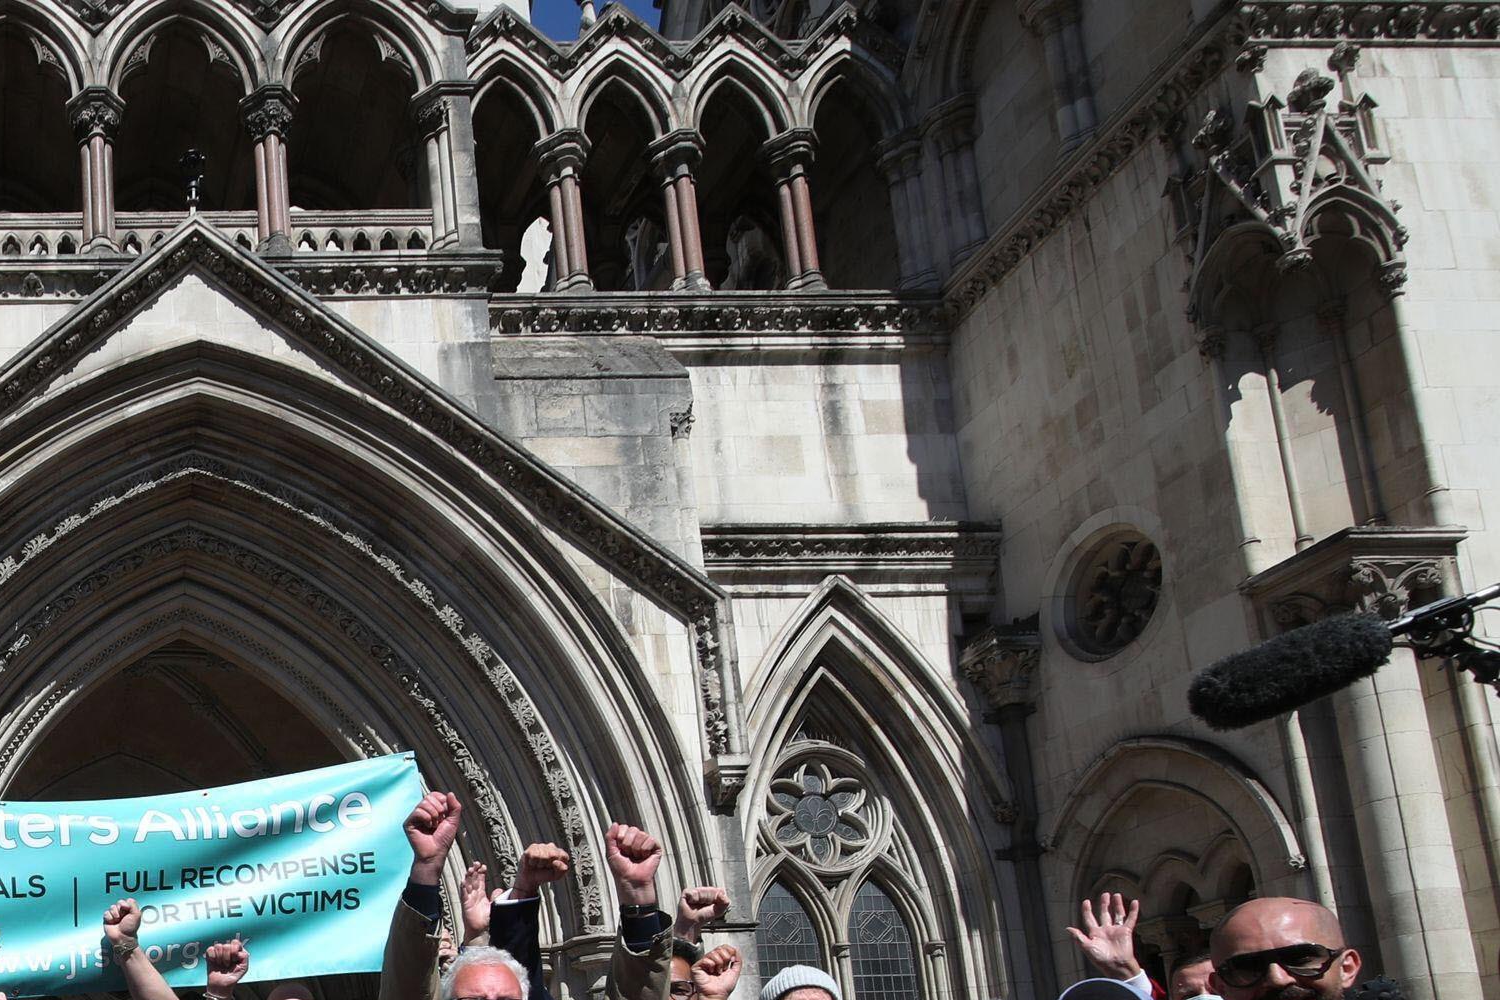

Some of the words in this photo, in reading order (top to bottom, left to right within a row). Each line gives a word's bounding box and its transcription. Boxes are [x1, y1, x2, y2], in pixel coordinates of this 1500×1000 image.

[133, 791, 373, 844] Alliance
[105, 869, 173, 894] FULL
[180, 851, 376, 890] RECOMPENSE
[141, 904, 181, 926] OR
[184, 898, 244, 921] THE
[249, 887, 361, 917] VICTIMS
